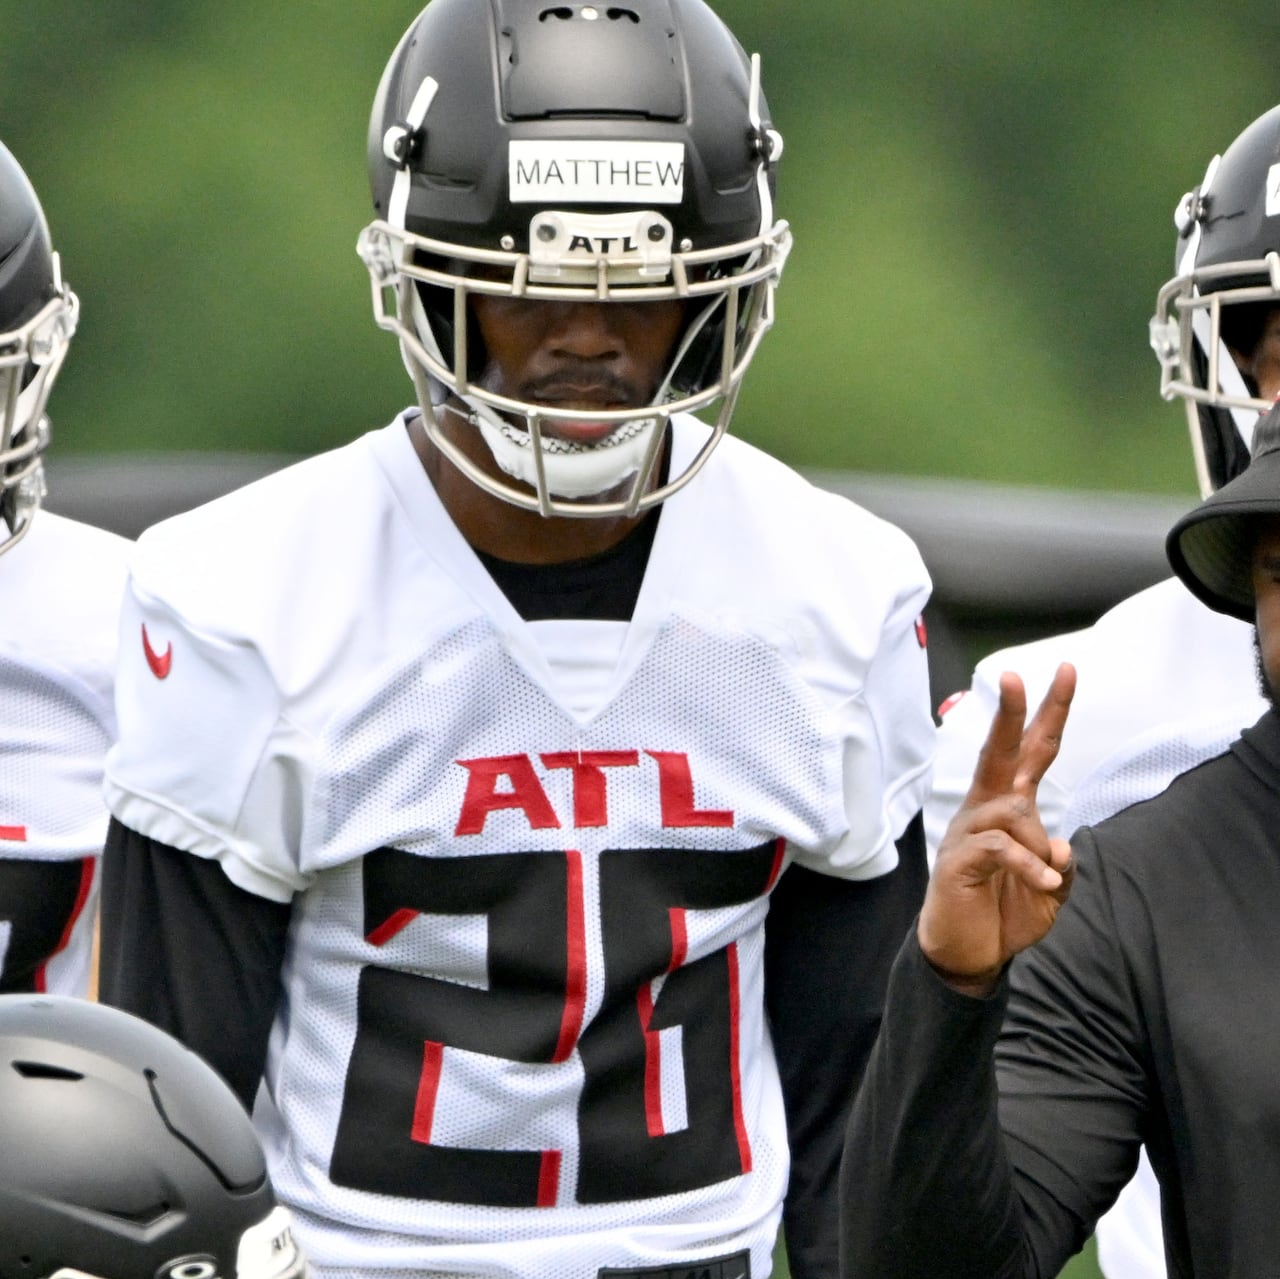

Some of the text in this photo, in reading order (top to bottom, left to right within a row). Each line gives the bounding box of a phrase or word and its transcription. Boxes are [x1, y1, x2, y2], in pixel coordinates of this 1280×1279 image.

[516, 158, 685, 187] MATTHEW
[567, 234, 639, 254] ATL
[453, 749, 735, 837] ATL
[328, 836, 753, 1208] 26
